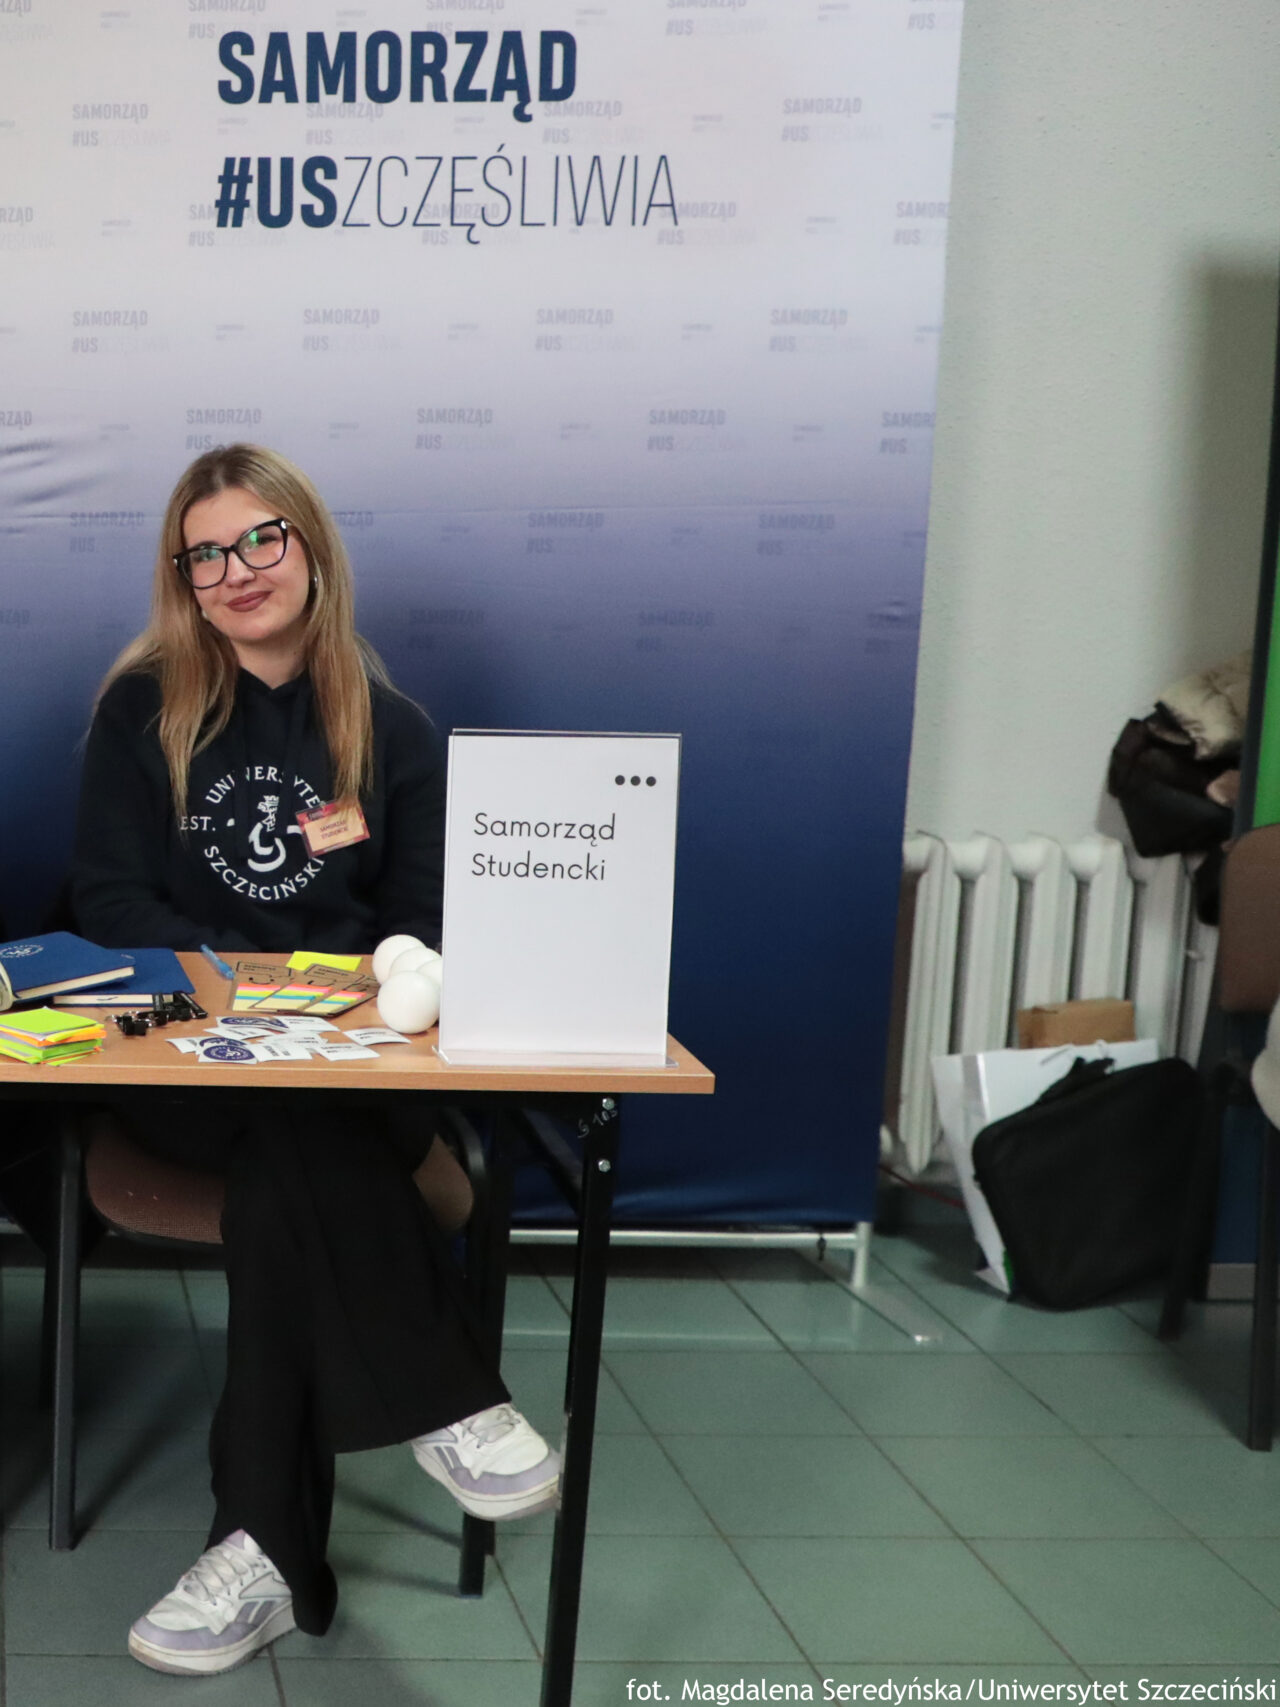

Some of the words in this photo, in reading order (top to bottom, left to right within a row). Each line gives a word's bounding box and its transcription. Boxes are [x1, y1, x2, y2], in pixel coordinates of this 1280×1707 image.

[217, 30, 578, 123] SAMORZĄD
[72, 103, 149, 124] SAMORZĄD
[782, 97, 863, 118] SAMORZĄD
[214, 143, 679, 245] #USZCZĘŚLIWIA
[72, 310, 148, 331] SAMORZĄD
[303, 308, 380, 329] SAMORZĄD
[536, 308, 614, 329] SAMORZĄD
[770, 309, 848, 330] SAMORZĄD
[186, 408, 262, 428] SAMORZĄD
[416, 408, 493, 428] SAMORZĄD
[648, 408, 726, 429] SAMORZĄD
[473, 812, 616, 848] Samorząd
[204, 845, 326, 900] SZCZECIŃSKI
[471, 850, 605, 881] Studencki
